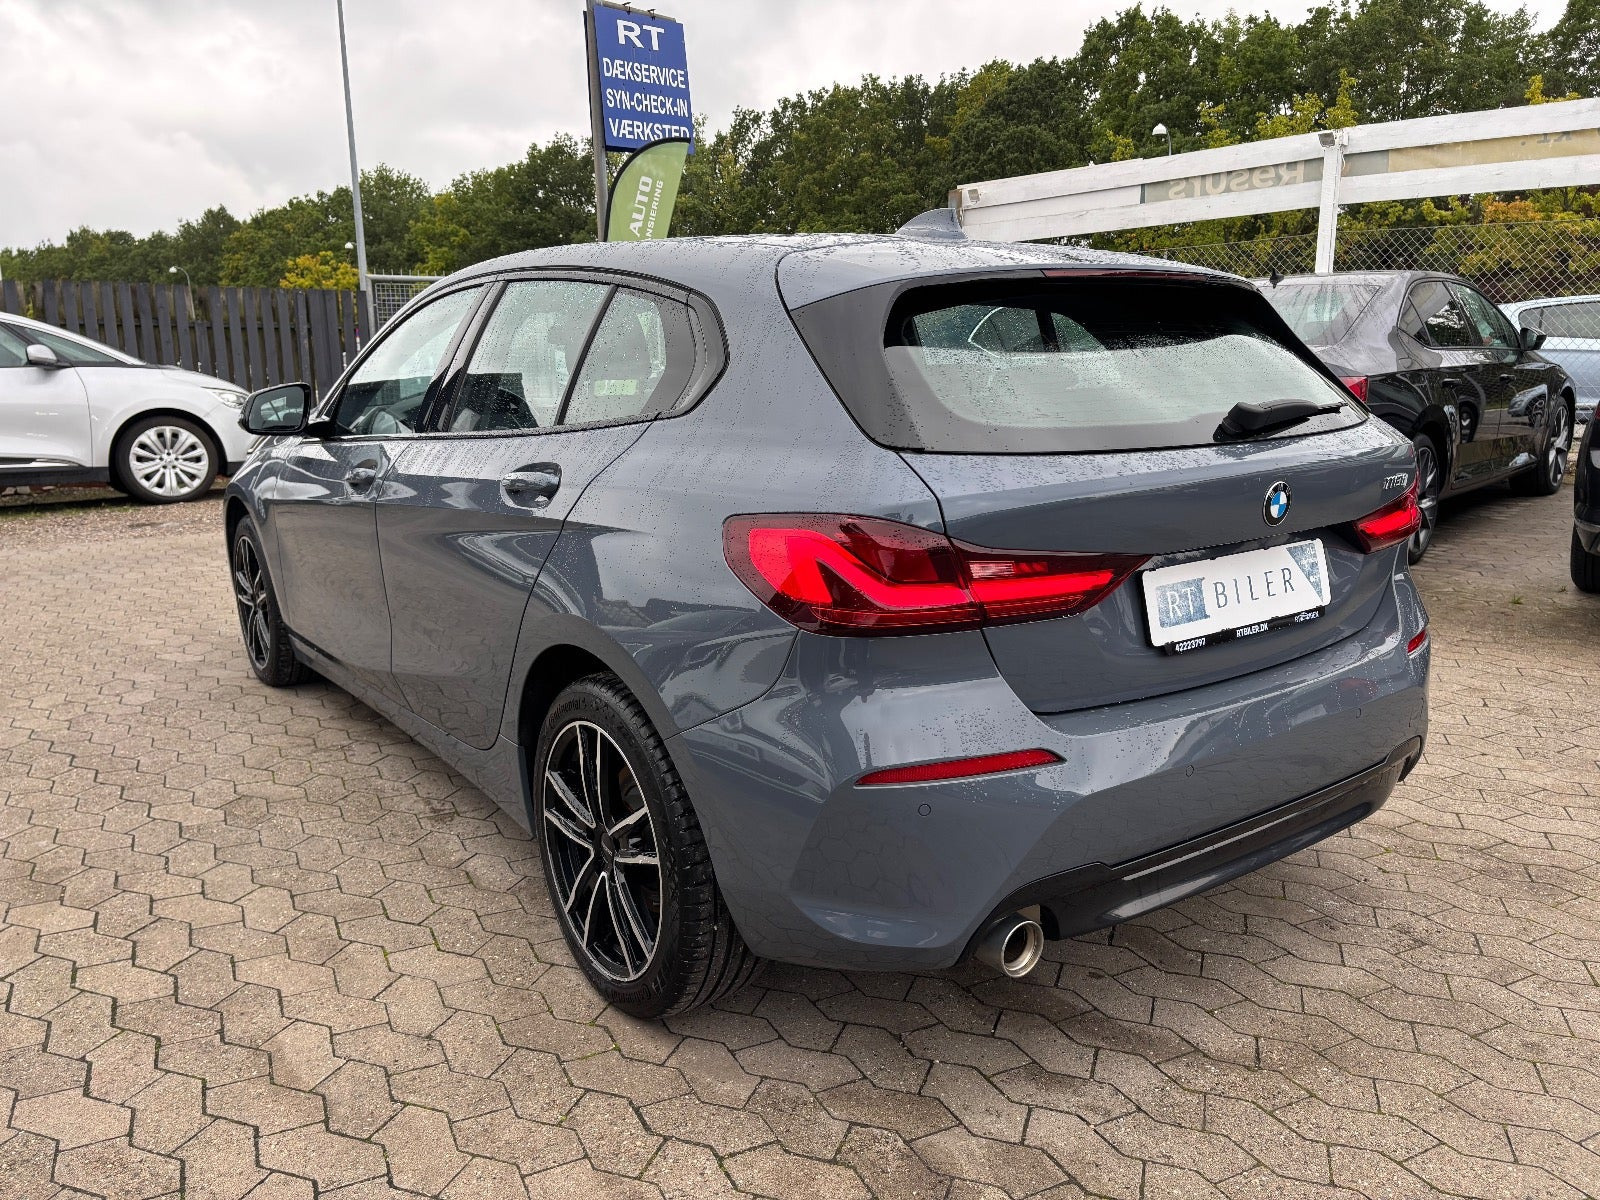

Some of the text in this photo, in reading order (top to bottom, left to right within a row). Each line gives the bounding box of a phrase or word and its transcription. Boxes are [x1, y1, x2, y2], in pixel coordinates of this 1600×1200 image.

[616, 19, 665, 51] RT
[602, 57, 686, 89] DÆKSERVICE
[606, 88, 689, 118] SYN-CHECK-IN
[608, 117, 690, 142] VÆRKSTED
[629, 175, 653, 238] AUTO
[1166, 567, 1295, 619] RT BILER
[1175, 637, 1206, 652] 42223797
[1236, 623, 1269, 638] RTBILER.DK
